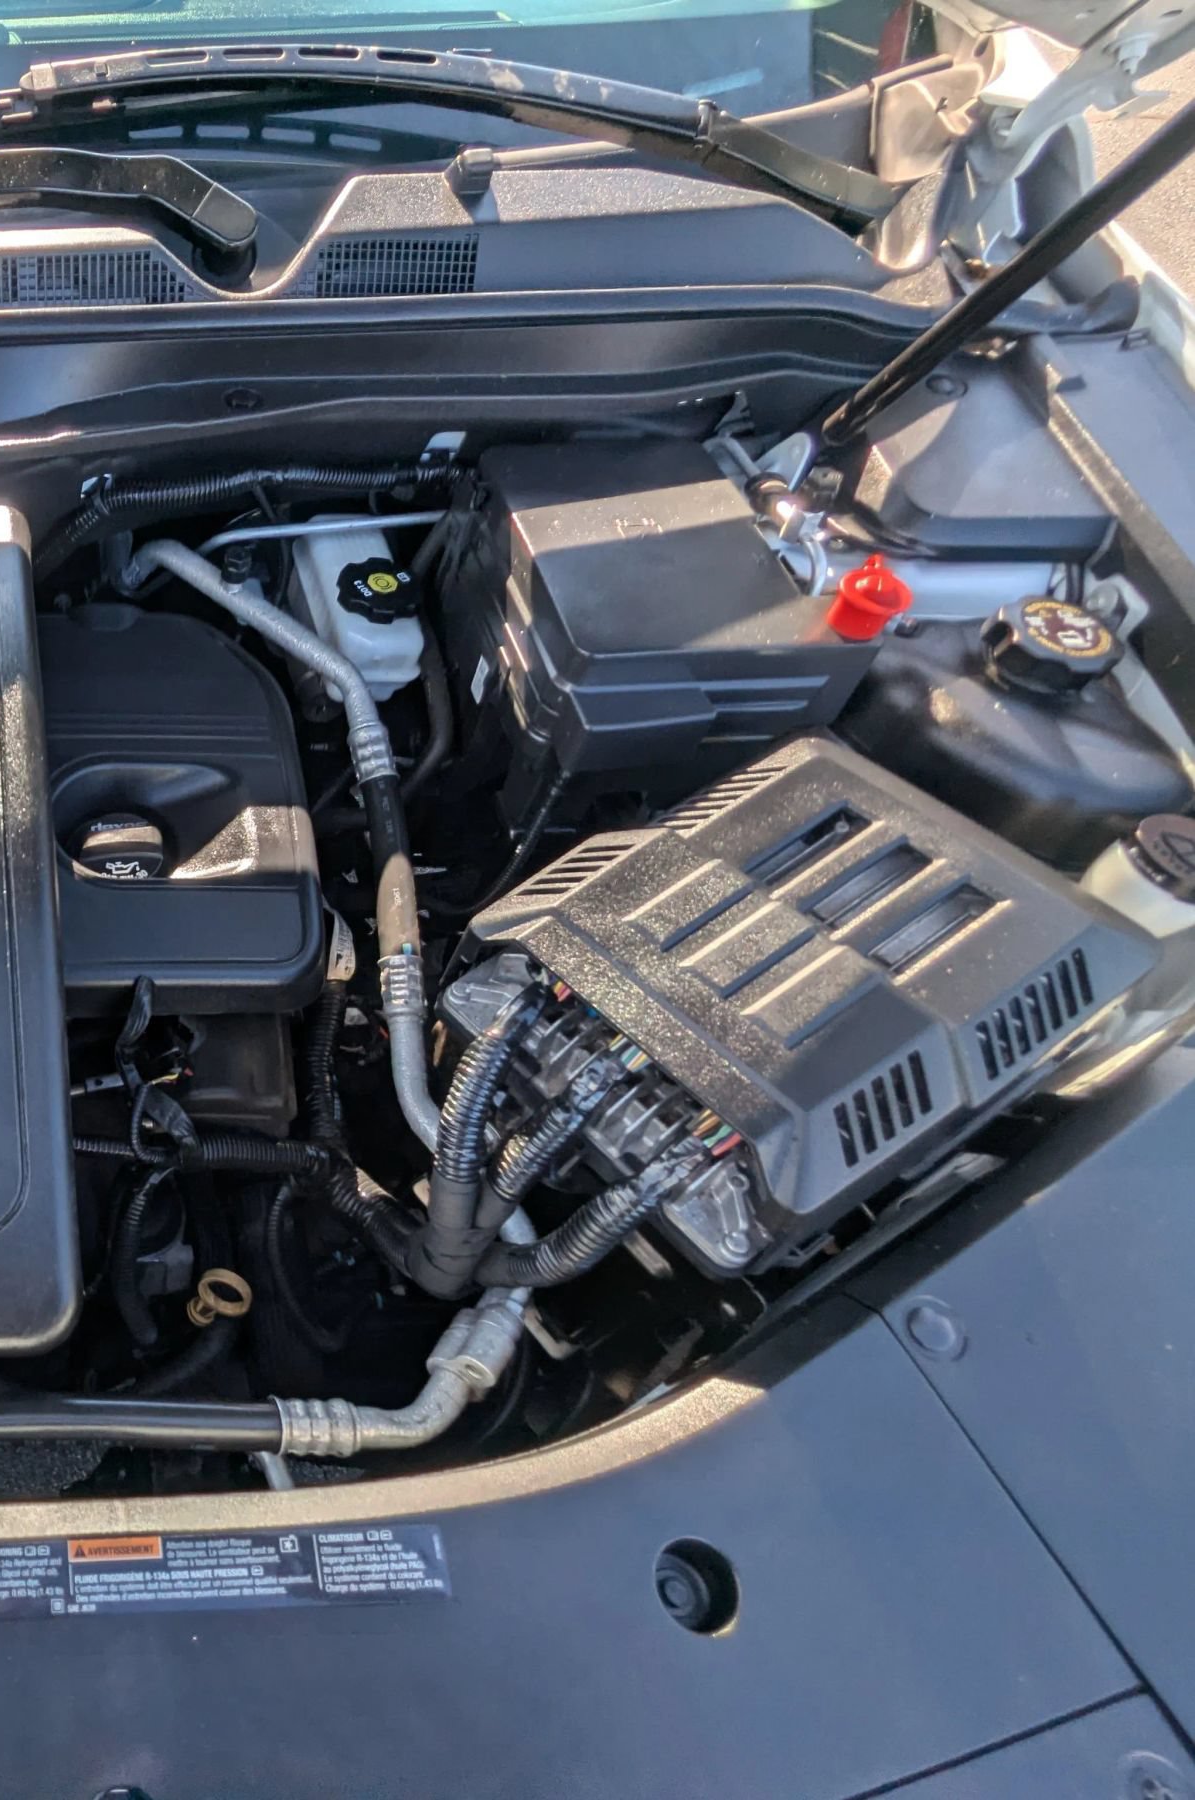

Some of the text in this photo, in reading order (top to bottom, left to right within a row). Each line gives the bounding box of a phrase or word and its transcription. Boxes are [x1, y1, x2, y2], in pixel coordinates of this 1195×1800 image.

[319, 1533, 363, 1542] CLIMATISEUR
[88, 1545, 153, 1555] AVERTISSEMENT
[75, 1575, 98, 1584] FLUIDE
[190, 1569, 212, 1578] HAUTE
[214, 1568, 248, 1577] PRESSION
